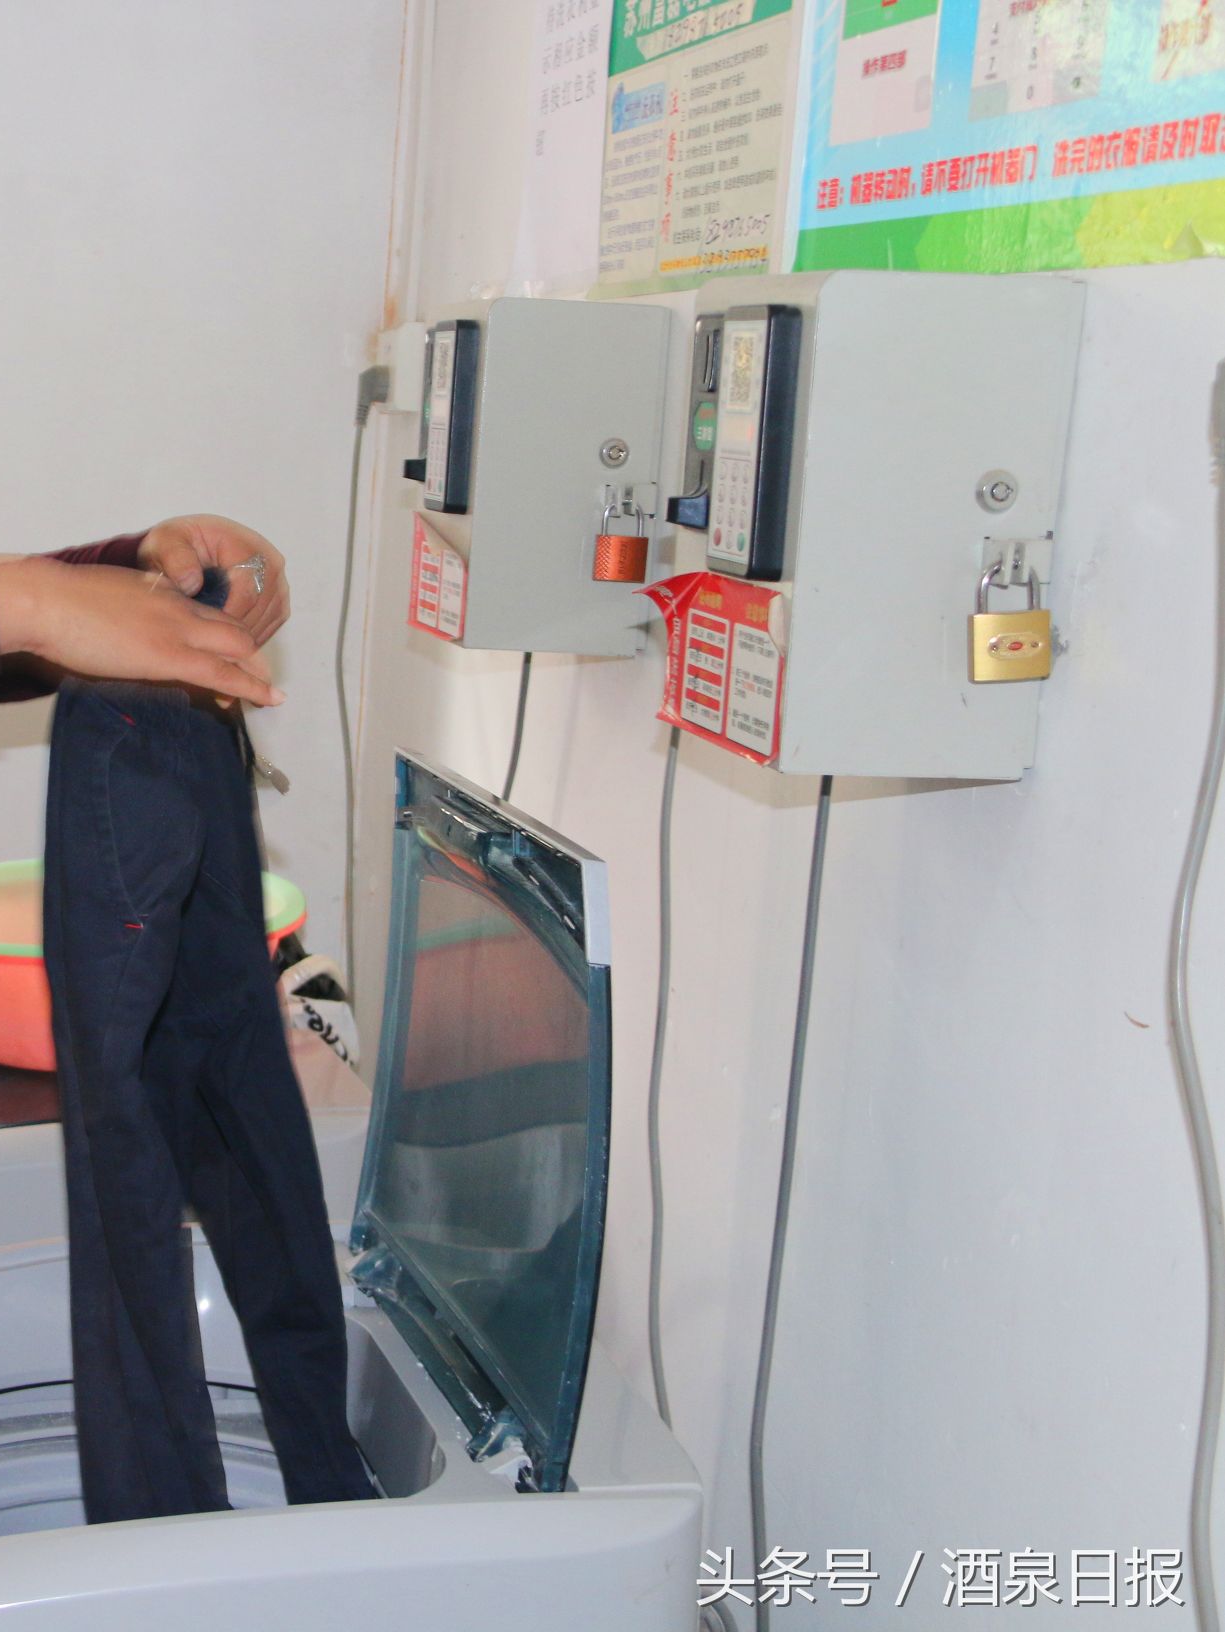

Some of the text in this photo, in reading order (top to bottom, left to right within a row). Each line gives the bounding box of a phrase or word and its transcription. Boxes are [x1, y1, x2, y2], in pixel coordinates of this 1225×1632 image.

[1051, 113, 1225, 178] 洗完的衣服请及时取
